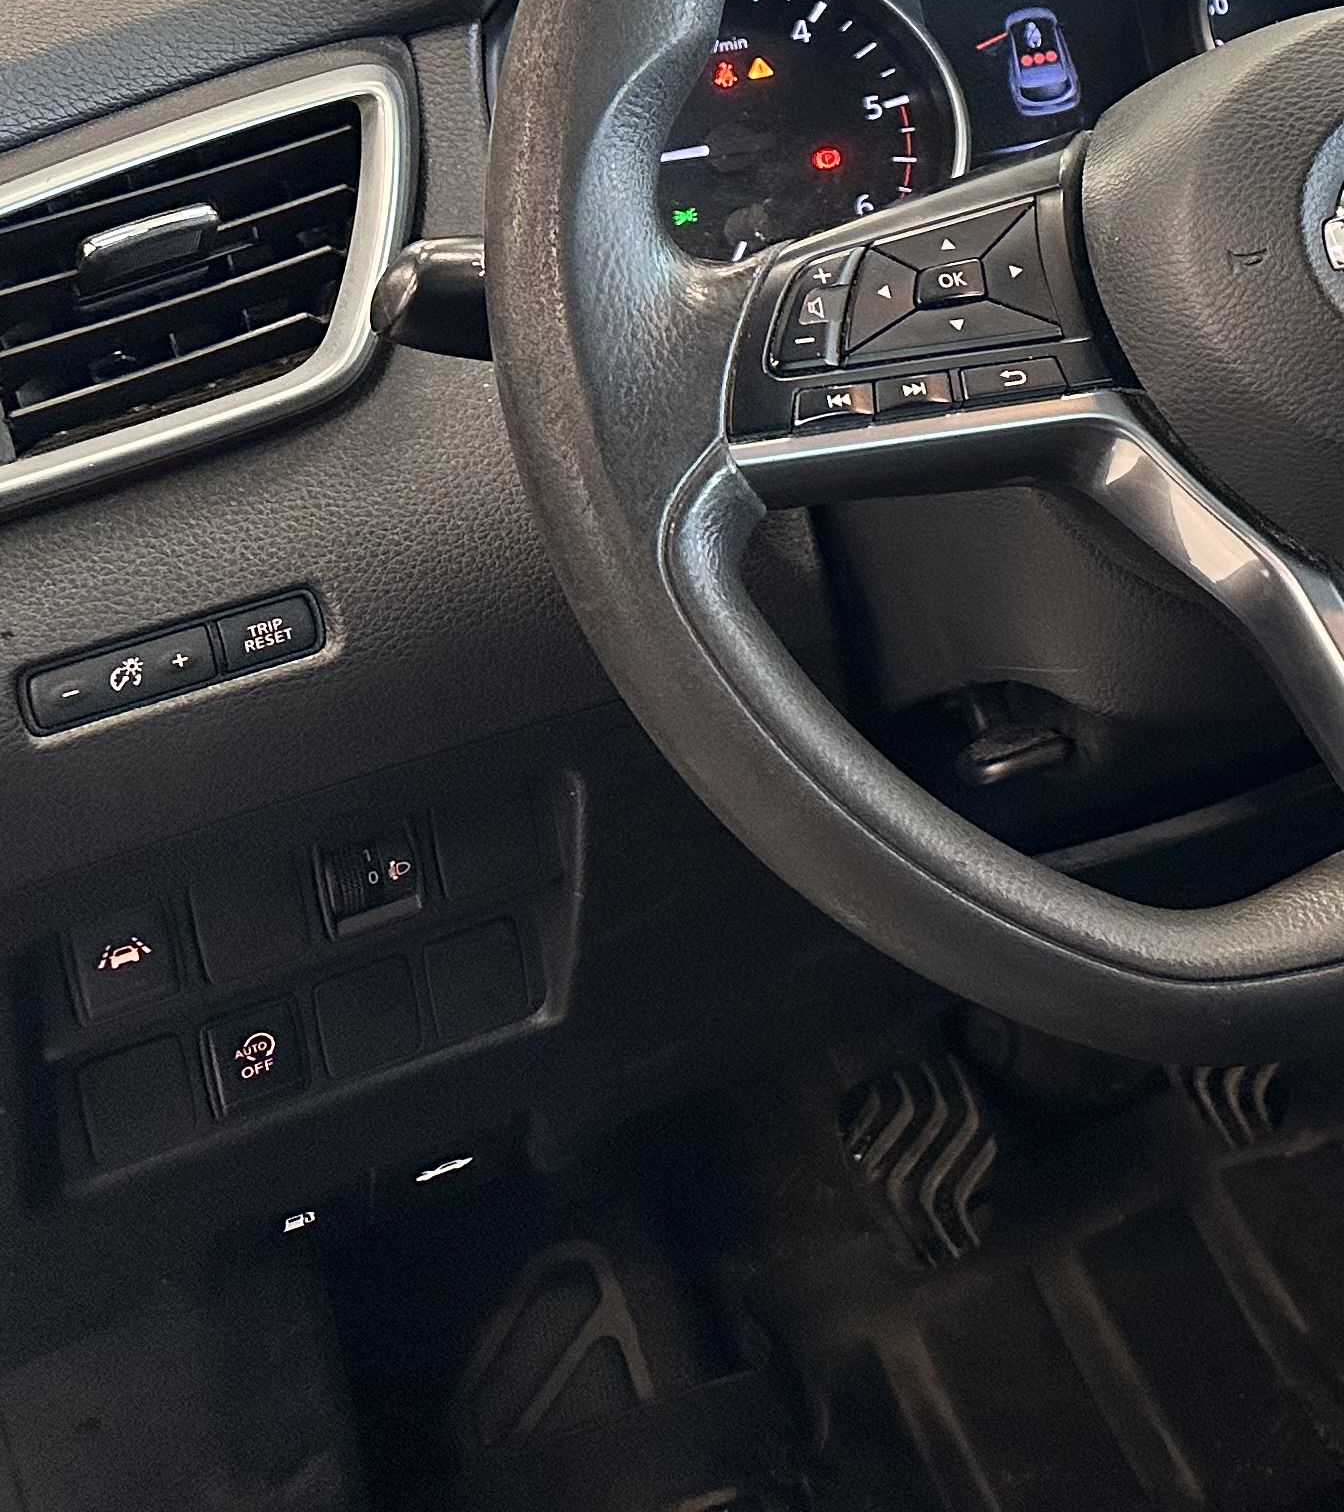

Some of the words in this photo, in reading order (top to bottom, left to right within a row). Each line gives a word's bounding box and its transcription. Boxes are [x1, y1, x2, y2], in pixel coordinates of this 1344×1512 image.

[792, 19, 812, 43] 4
[711, 37, 748, 54] /min
[864, 95, 883, 120] 5
[854, 194, 874, 216] 6
[938, 271, 968, 289] OK
[247, 618, 284, 638] TRIP
[244, 627, 294, 654] RESET
[368, 870, 379, 885] 0
[234, 1041, 268, 1060] AUTO
[241, 1058, 274, 1079] OFF
